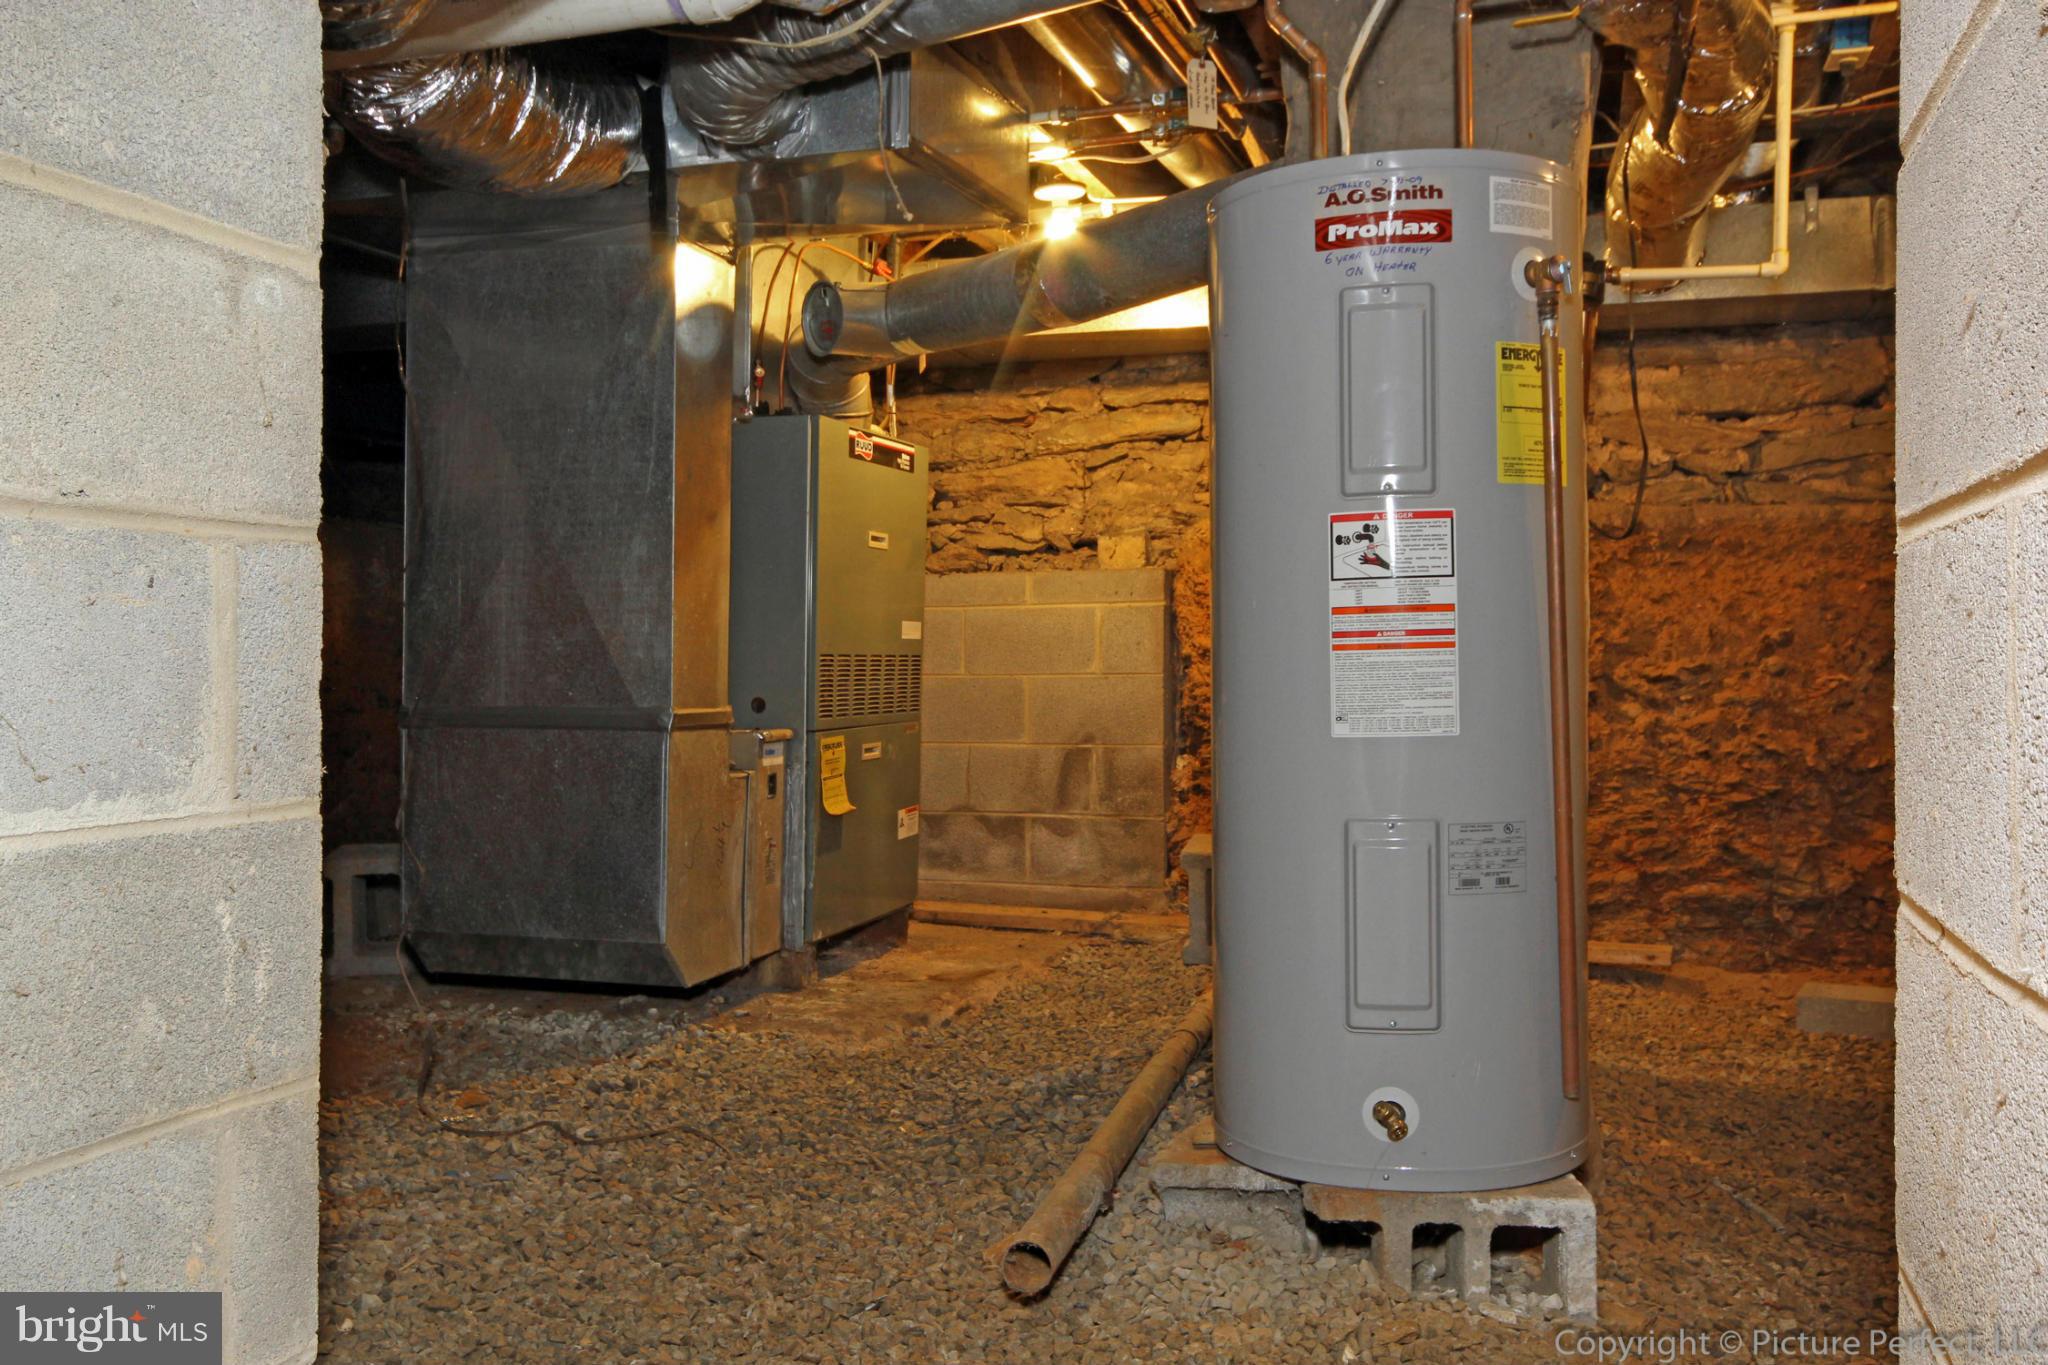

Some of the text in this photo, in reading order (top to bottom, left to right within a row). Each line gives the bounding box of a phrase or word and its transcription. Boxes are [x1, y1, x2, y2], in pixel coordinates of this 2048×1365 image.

[1328, 220, 1438, 242] ProMax
[1325, 252, 1333, 264] 6
[1369, 245, 1432, 256] WARRANTY
[1345, 260, 1417, 277] ON HEATER
